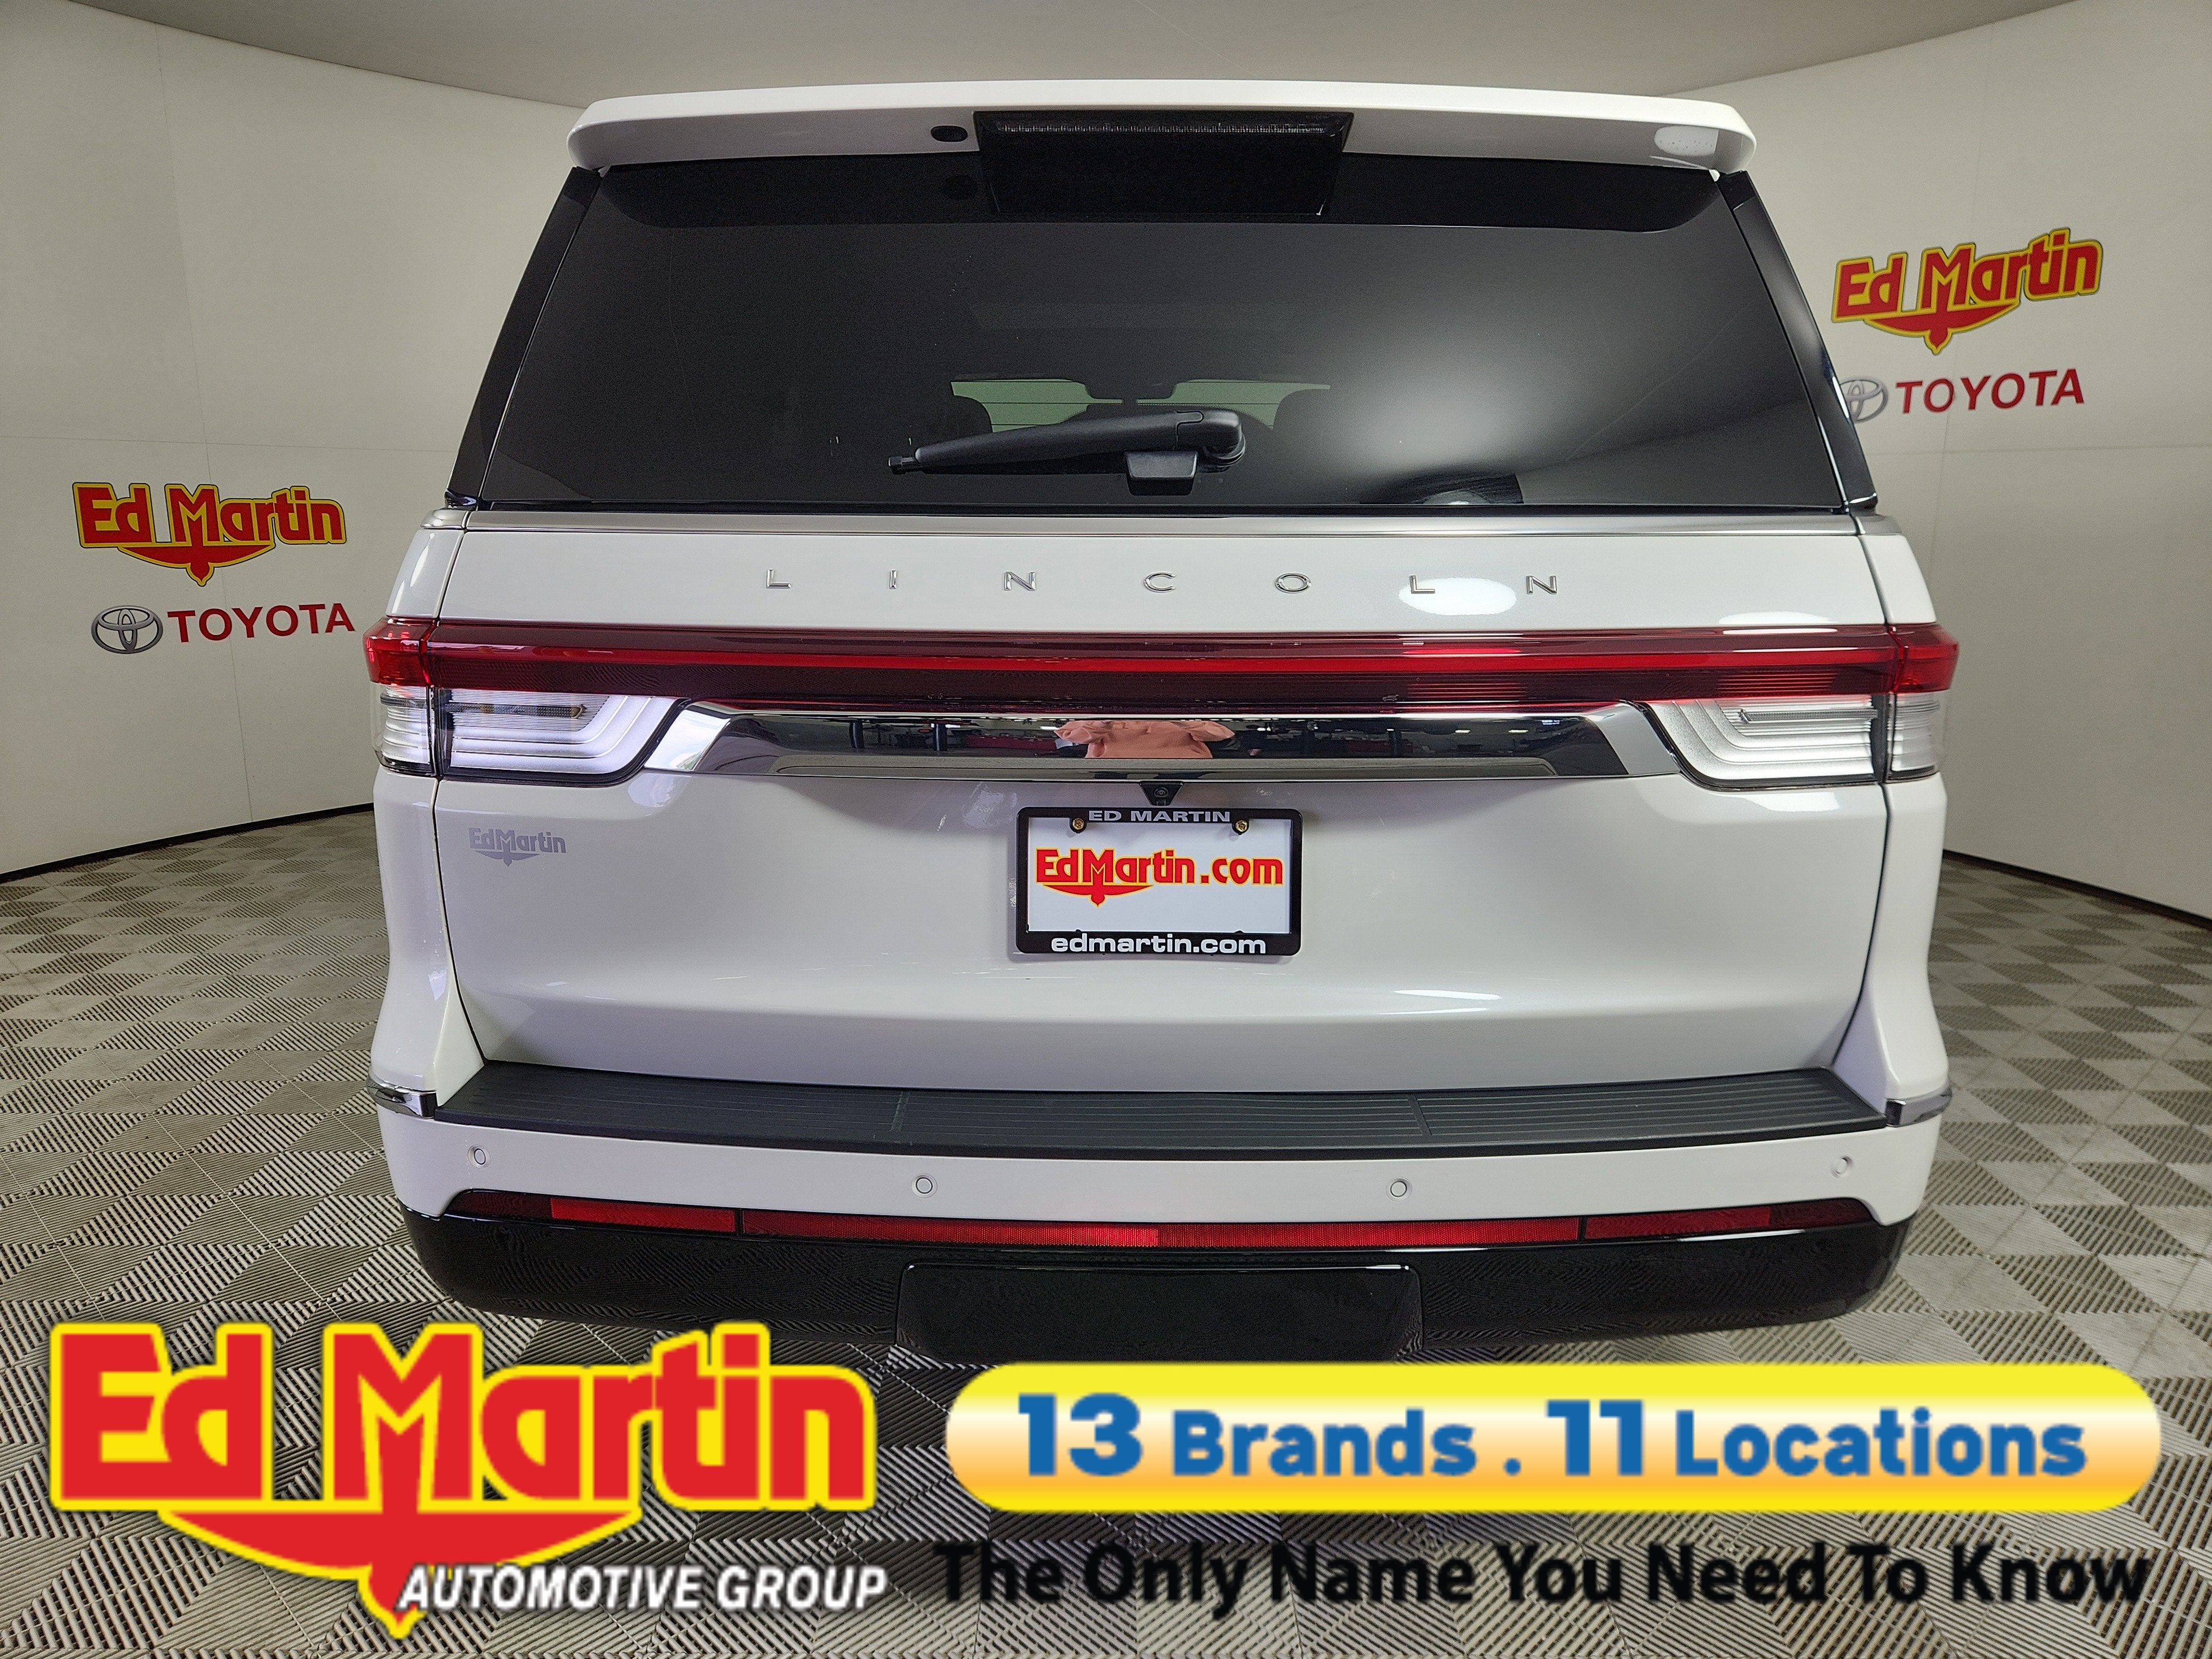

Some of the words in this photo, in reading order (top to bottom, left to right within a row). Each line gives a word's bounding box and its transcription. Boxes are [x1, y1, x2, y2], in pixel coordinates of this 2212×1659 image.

[1832, 253, 1907, 321] Ed
[1918, 228, 2102, 309] Martin
[1896, 369, 2084, 414] TOYOTA
[72, 482, 156, 548] Ed
[164, 484, 346, 544] Martin
[766, 568, 1557, 595] LINCOLN
[167, 603, 355, 642] TOYOTA
[1089, 811, 1124, 821] ED
[1131, 811, 1230, 822] MARTIN
[469, 828, 566, 853] EdMartin
[1051, 933, 1266, 954] edmartin.com
